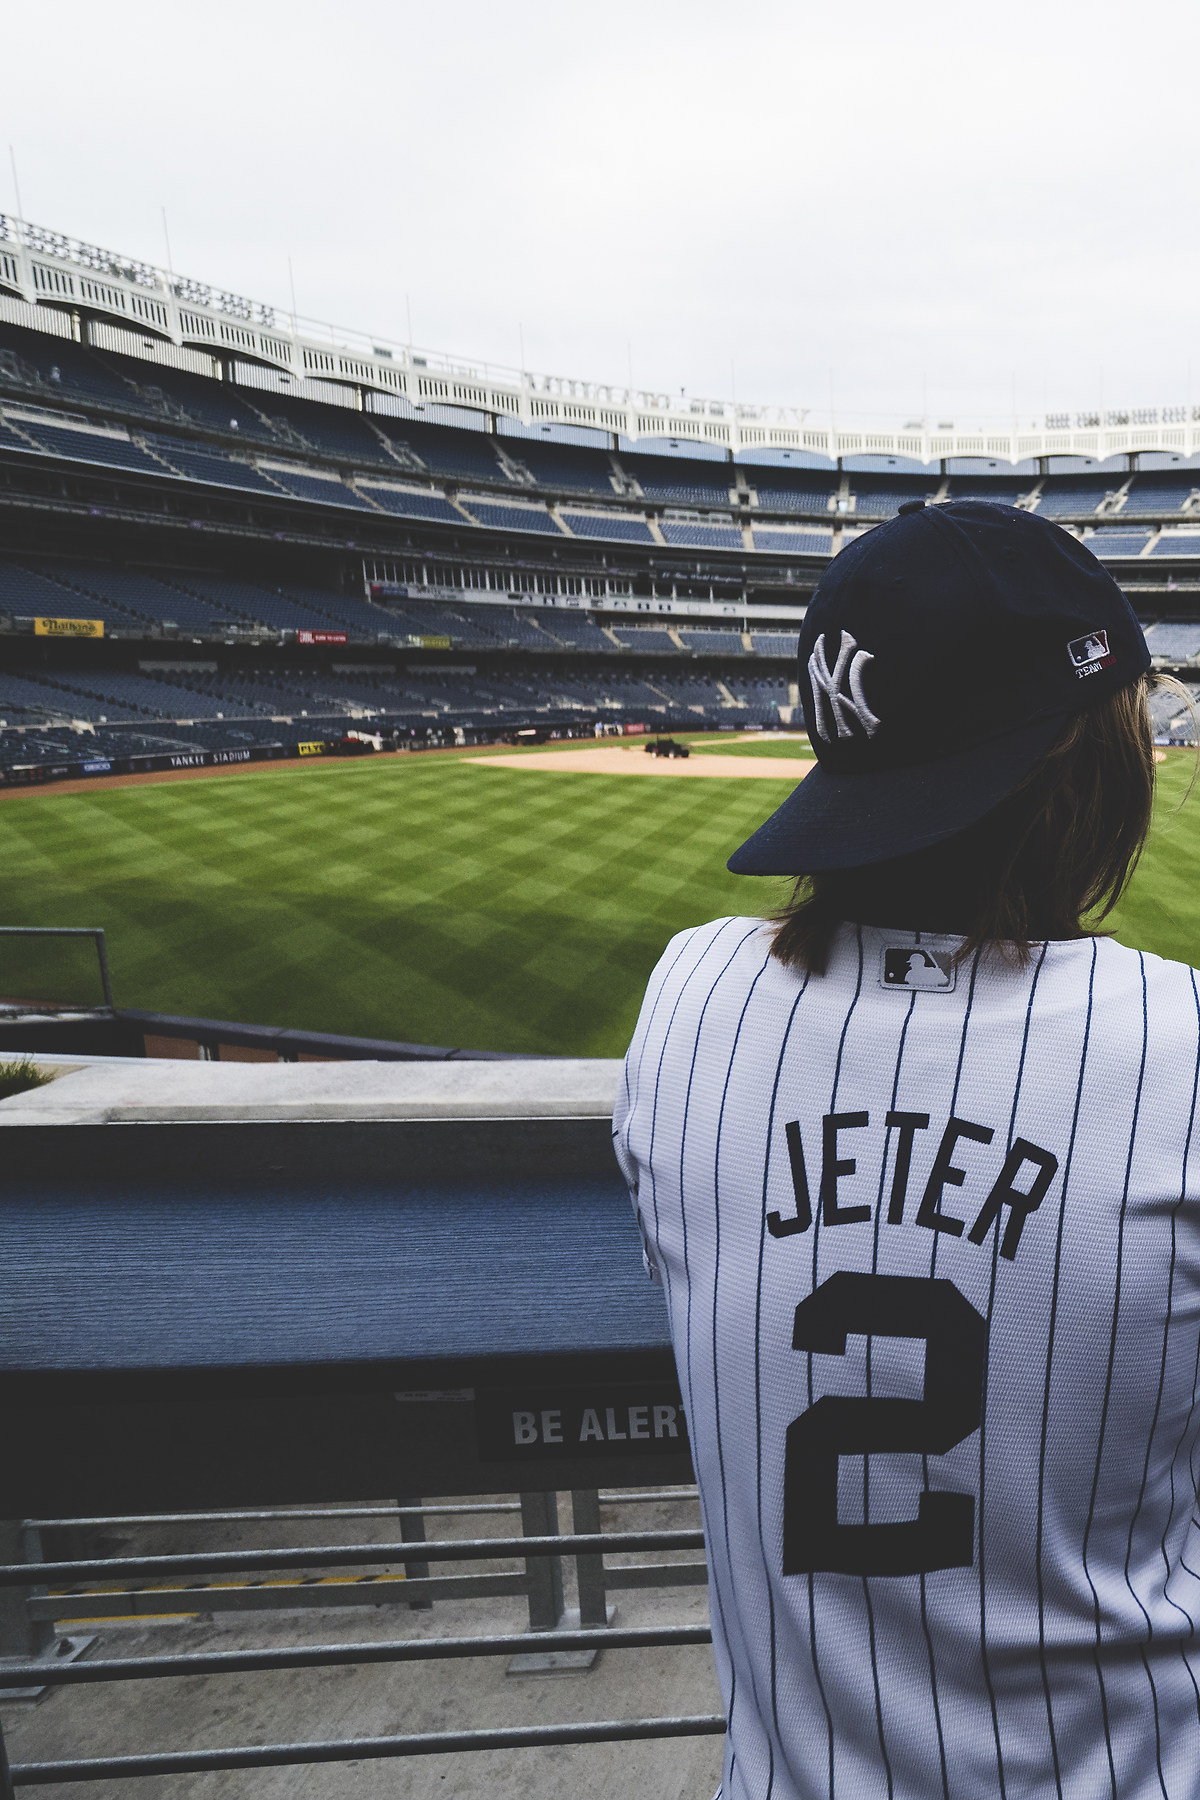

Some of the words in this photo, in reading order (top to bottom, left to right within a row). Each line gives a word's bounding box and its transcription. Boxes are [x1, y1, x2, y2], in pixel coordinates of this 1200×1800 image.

[808, 629, 881, 743] NY
[171, 755, 205, 766] YANKEE
[213, 750, 250, 763] STADIUM
[766, 1110, 1059, 1262] JETER
[512, 1411, 564, 1444] BE
[579, 1405, 686, 1442] ALER
[782, 1271, 987, 1577] 2
